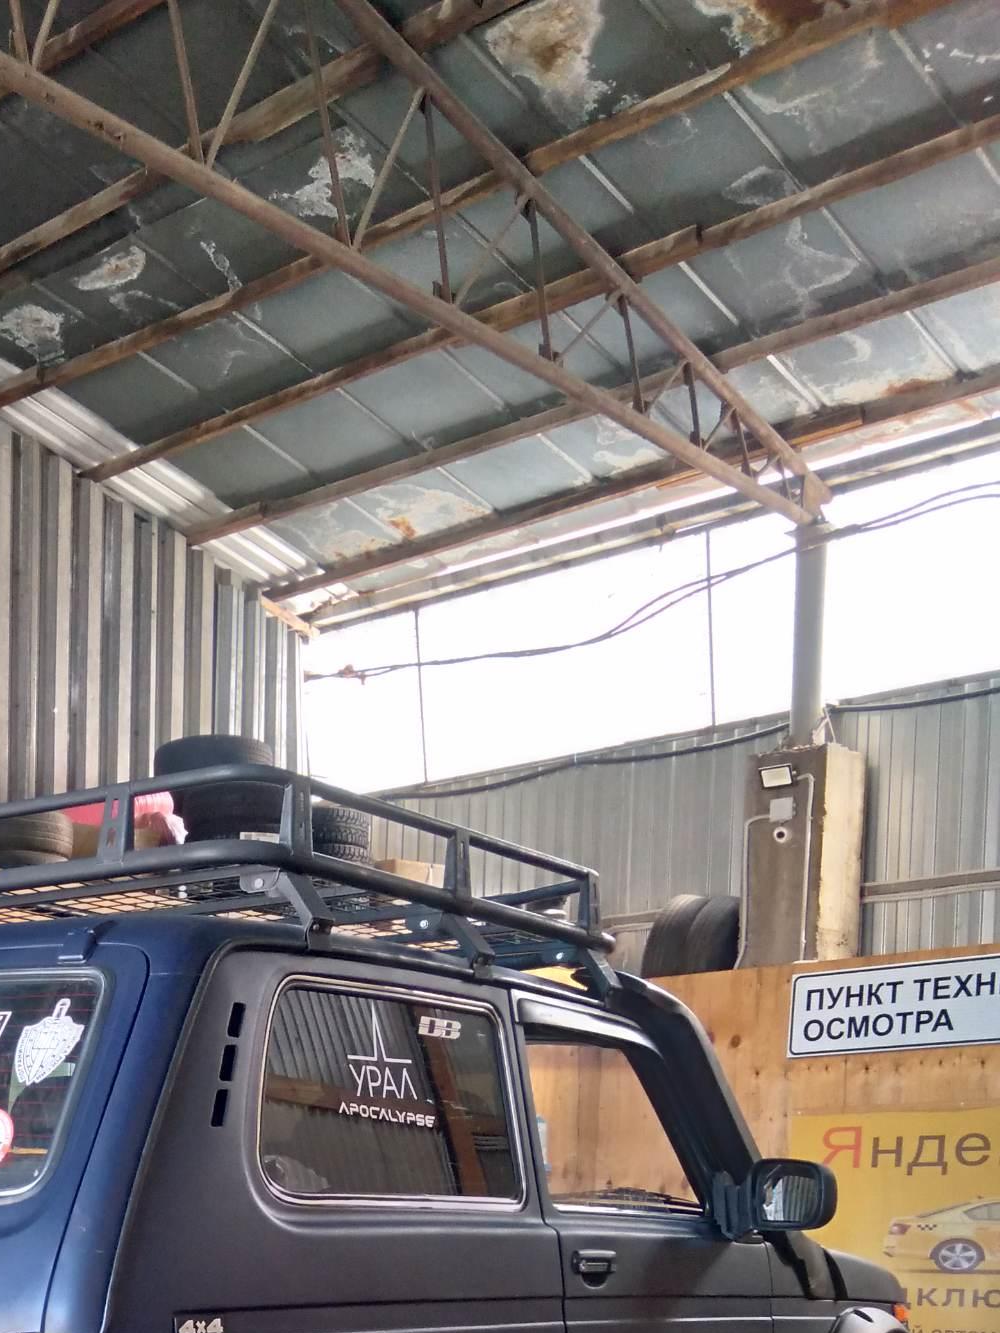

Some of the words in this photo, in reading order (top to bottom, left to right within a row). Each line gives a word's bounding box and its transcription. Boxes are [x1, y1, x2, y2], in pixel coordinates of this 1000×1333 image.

[806, 980, 904, 1011] ПУНКТ
[913, 971, 1000, 1001] ТЕХН
[418, 1016, 461, 1040] DB
[803, 1008, 954, 1042] ОСМОТРА
[349, 1063, 418, 1101] УРАЛ
[339, 1101, 436, 1128] APOCALYPSE
[823, 1126, 1000, 1176] Янде
